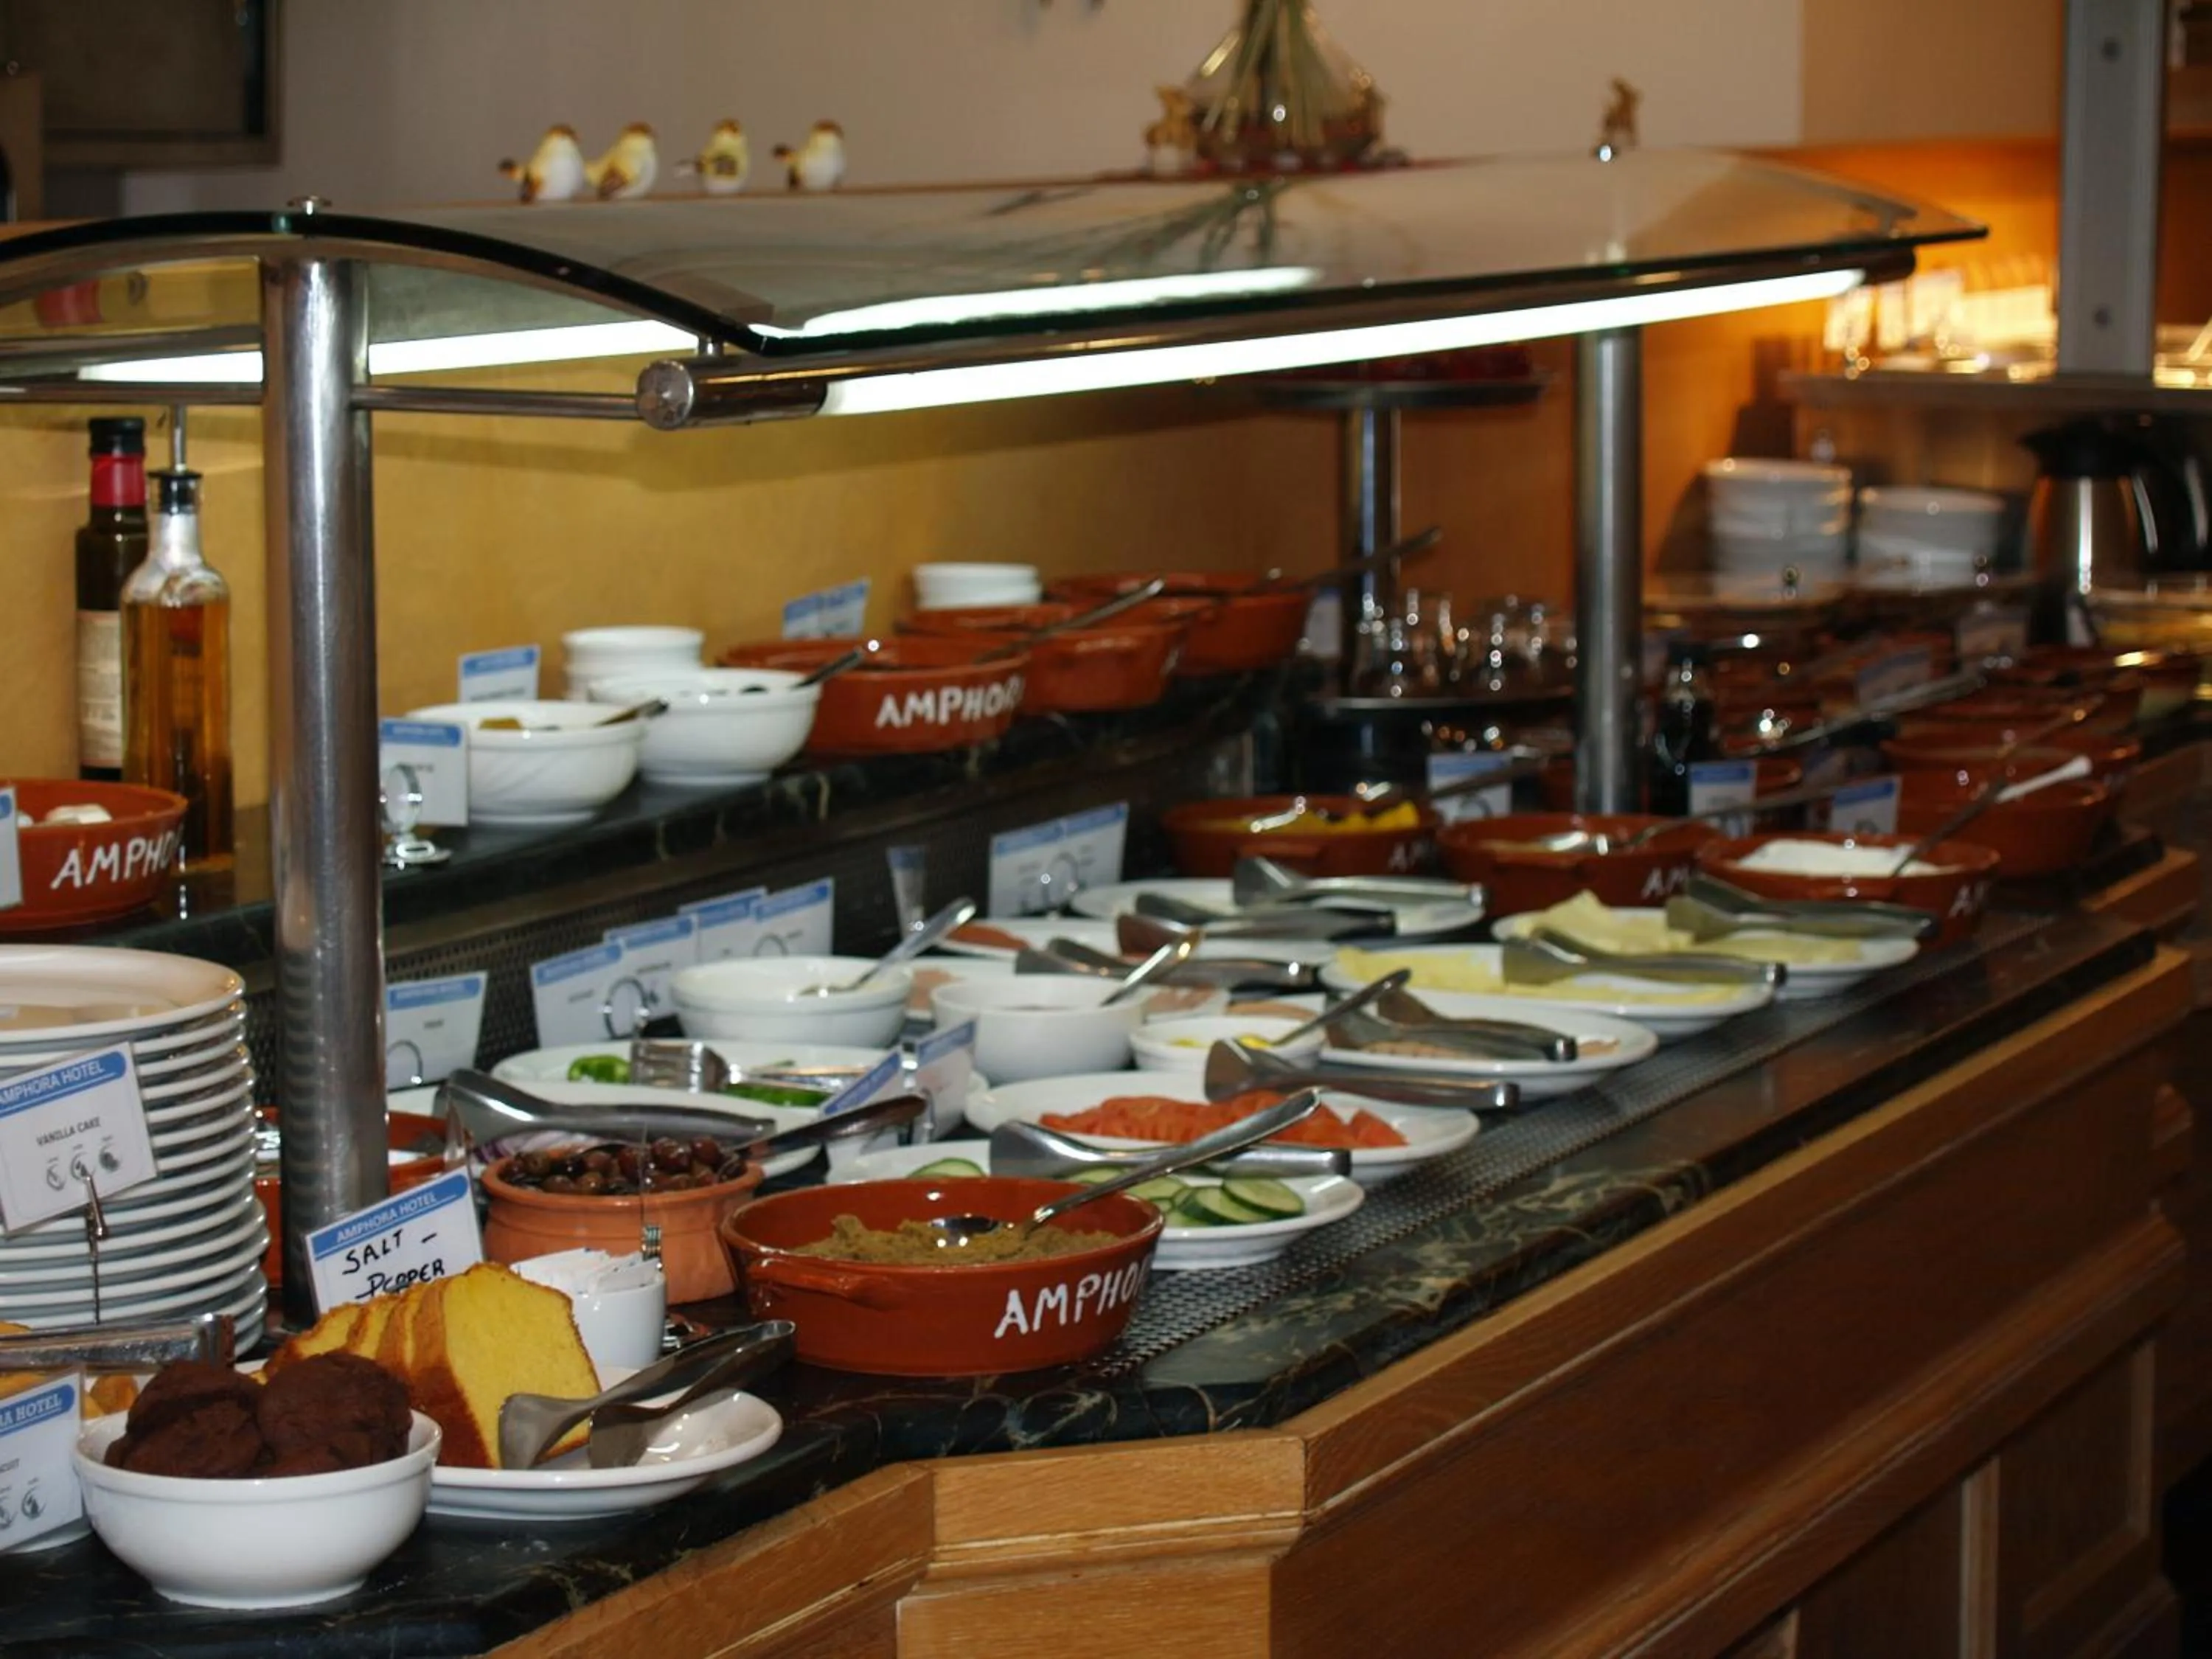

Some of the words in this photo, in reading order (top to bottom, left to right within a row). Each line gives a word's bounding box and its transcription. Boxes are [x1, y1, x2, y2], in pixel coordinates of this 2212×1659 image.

[0, 1074, 61, 1105] AMPHORA
[61, 1060, 105, 1085] HOTEL
[35, 1125, 76, 1147] VANILLA
[75, 1116, 102, 1133] CAKE
[335, 1208, 399, 1244] AMPHORA
[399, 1192, 437, 1217] HOTEL
[342, 1228, 403, 1276] SALT
[15, 1392, 63, 1422] HOTEL
